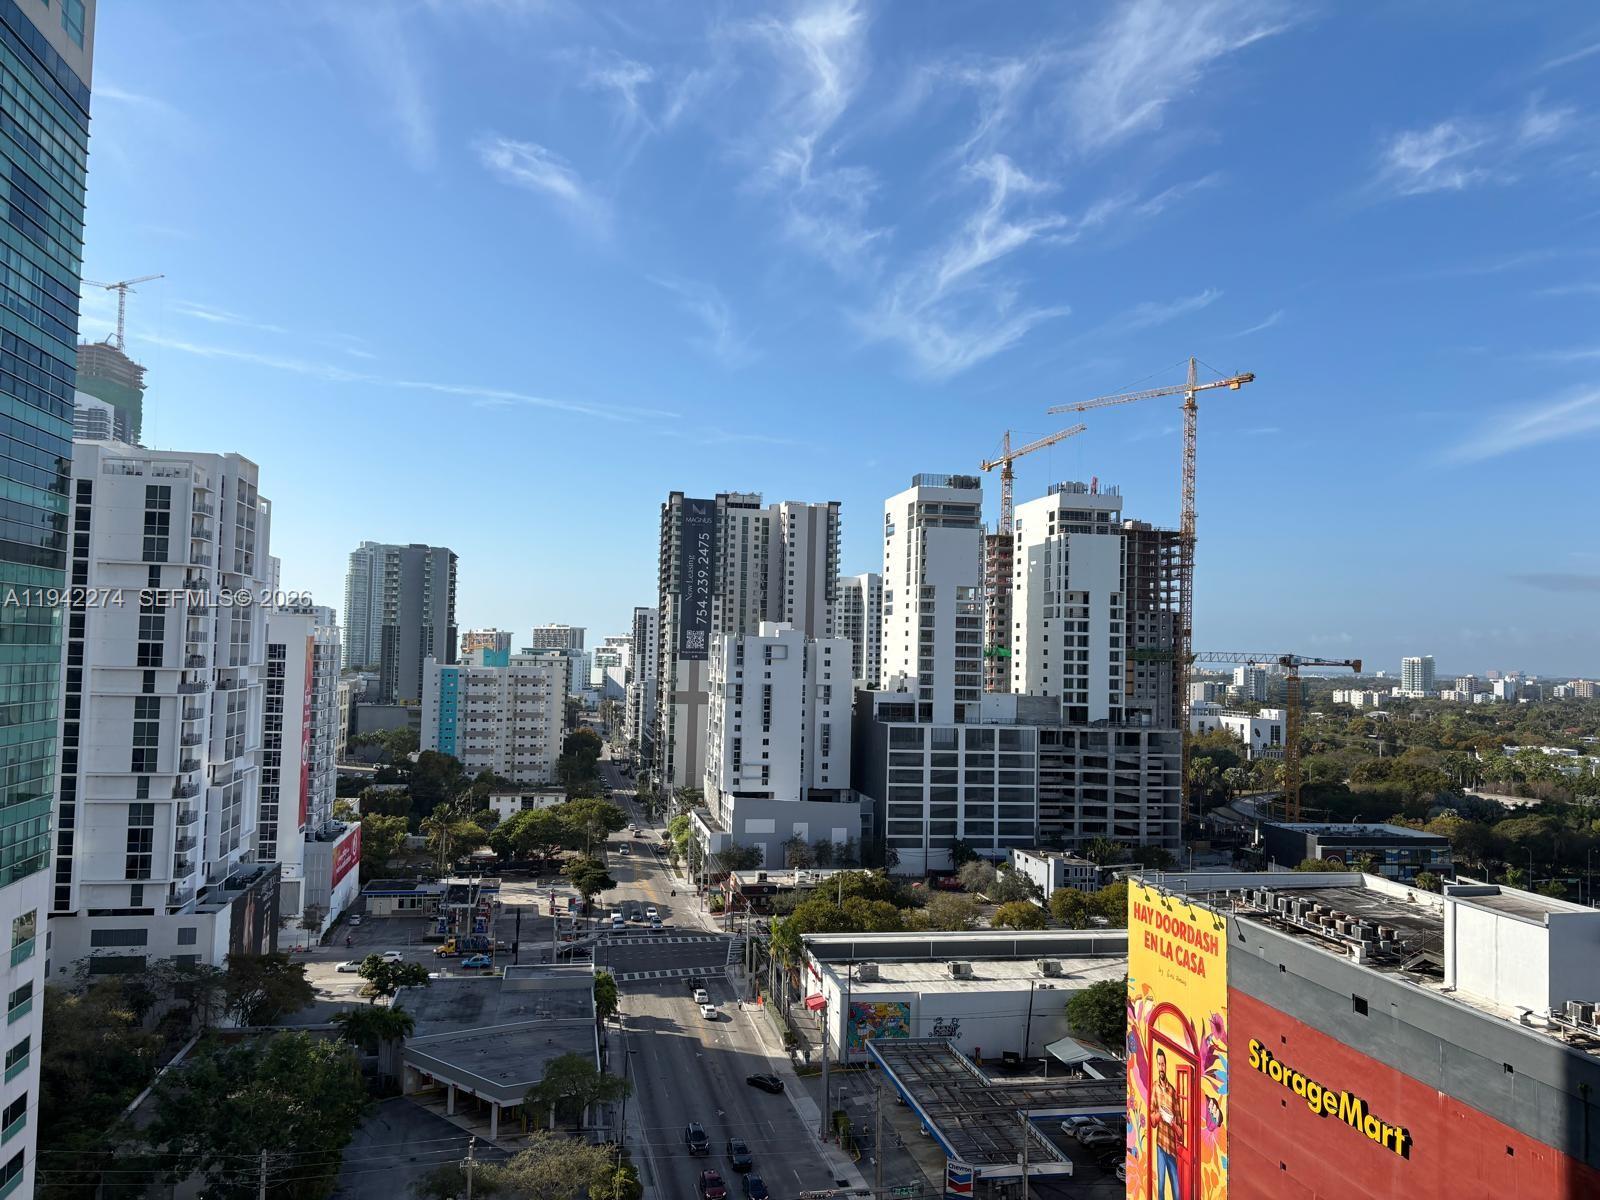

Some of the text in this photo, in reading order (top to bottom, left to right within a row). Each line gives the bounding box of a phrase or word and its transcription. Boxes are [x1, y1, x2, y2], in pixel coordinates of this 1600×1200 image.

[685, 516, 713, 524] MAGNUS
[685, 554, 696, 583] Leasing
[696, 532, 710, 625] 754.239.2475
[1133, 901, 1219, 957] HAY DOORDASH
[1144, 930, 1158, 953] EN
[1160, 937, 1174, 961] LA
[1175, 945, 1206, 979] CASA
[1248, 1038, 1408, 1157] StorageMart
[948, 1162, 973, 1173] Chevron
